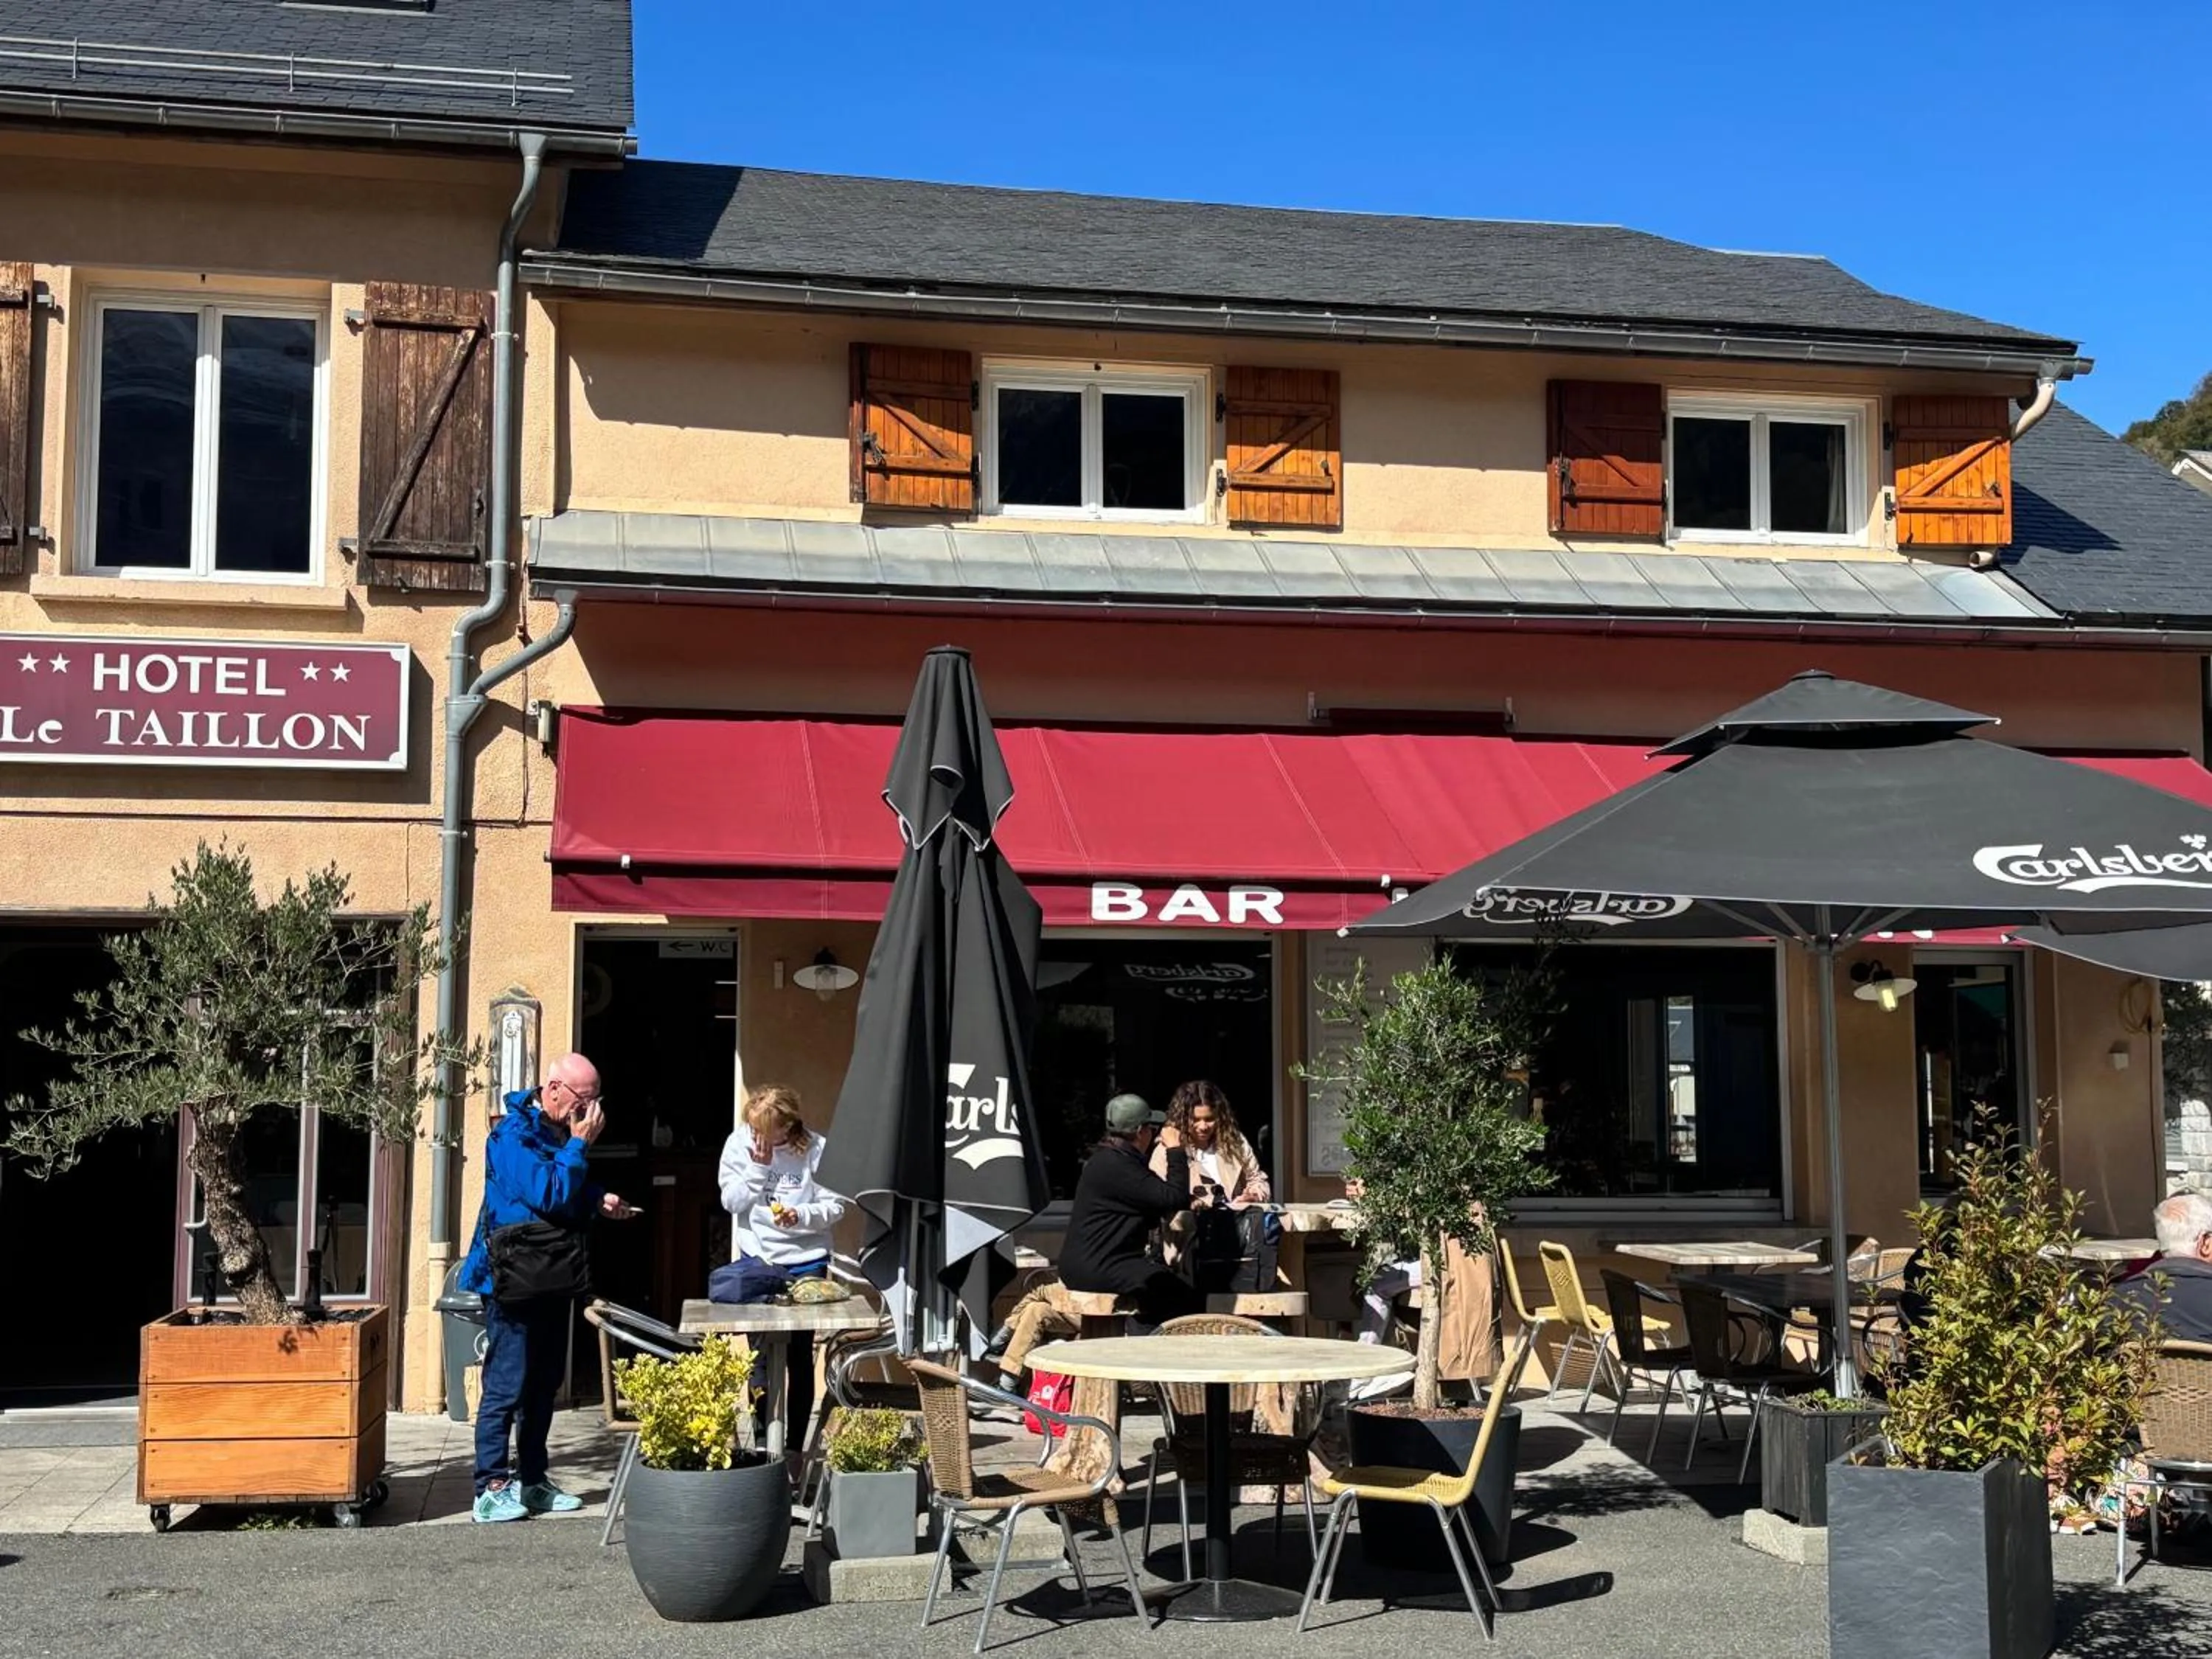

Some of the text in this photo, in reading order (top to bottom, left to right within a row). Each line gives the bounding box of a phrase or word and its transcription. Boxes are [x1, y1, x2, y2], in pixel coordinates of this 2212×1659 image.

[92, 653, 286, 696] HOTEL
[0, 706, 371, 751] Le TAILLON
[1091, 882, 1284, 925] BAR
